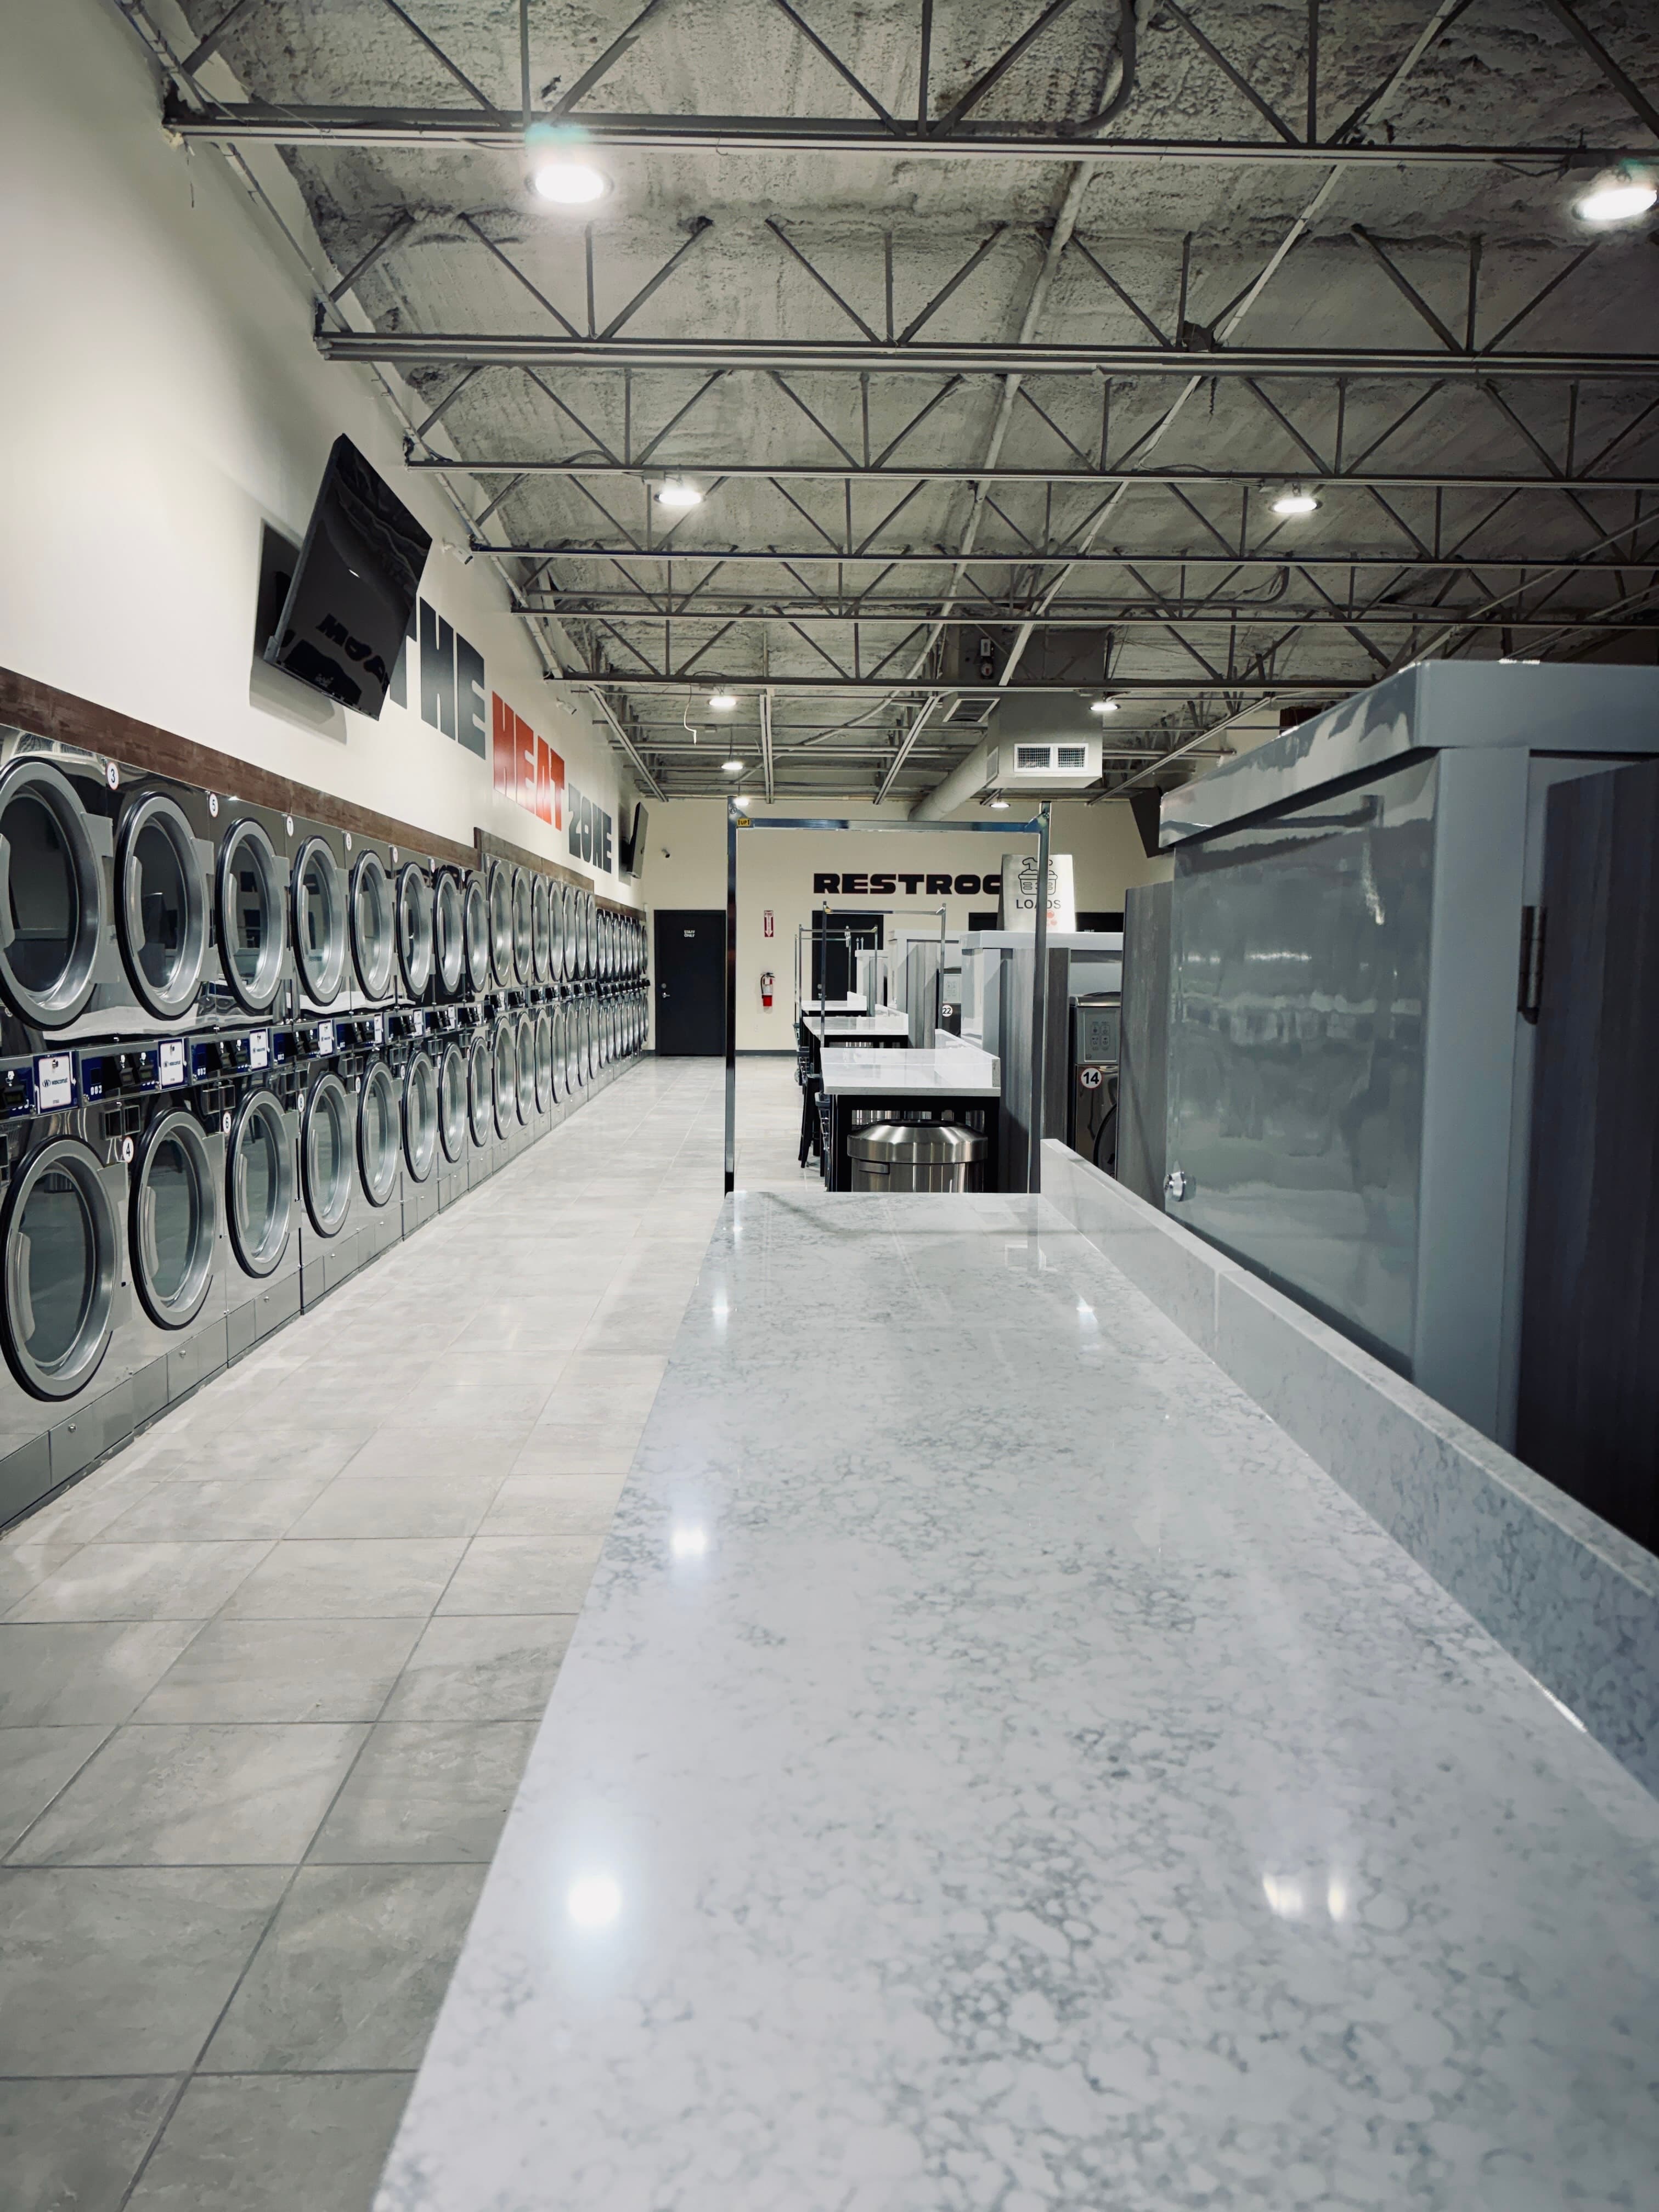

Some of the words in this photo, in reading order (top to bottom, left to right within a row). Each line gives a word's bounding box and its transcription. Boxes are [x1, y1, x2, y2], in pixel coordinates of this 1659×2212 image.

[110, 768, 116, 783] 3
[492, 690, 565, 832] HEAT
[568, 782, 612, 874] ZONE
[212, 799, 216, 811] 5
[1016, 899, 1062, 909] LODS
[1083, 1071, 1099, 1085] 14
[126, 1142, 131, 1156] 4
